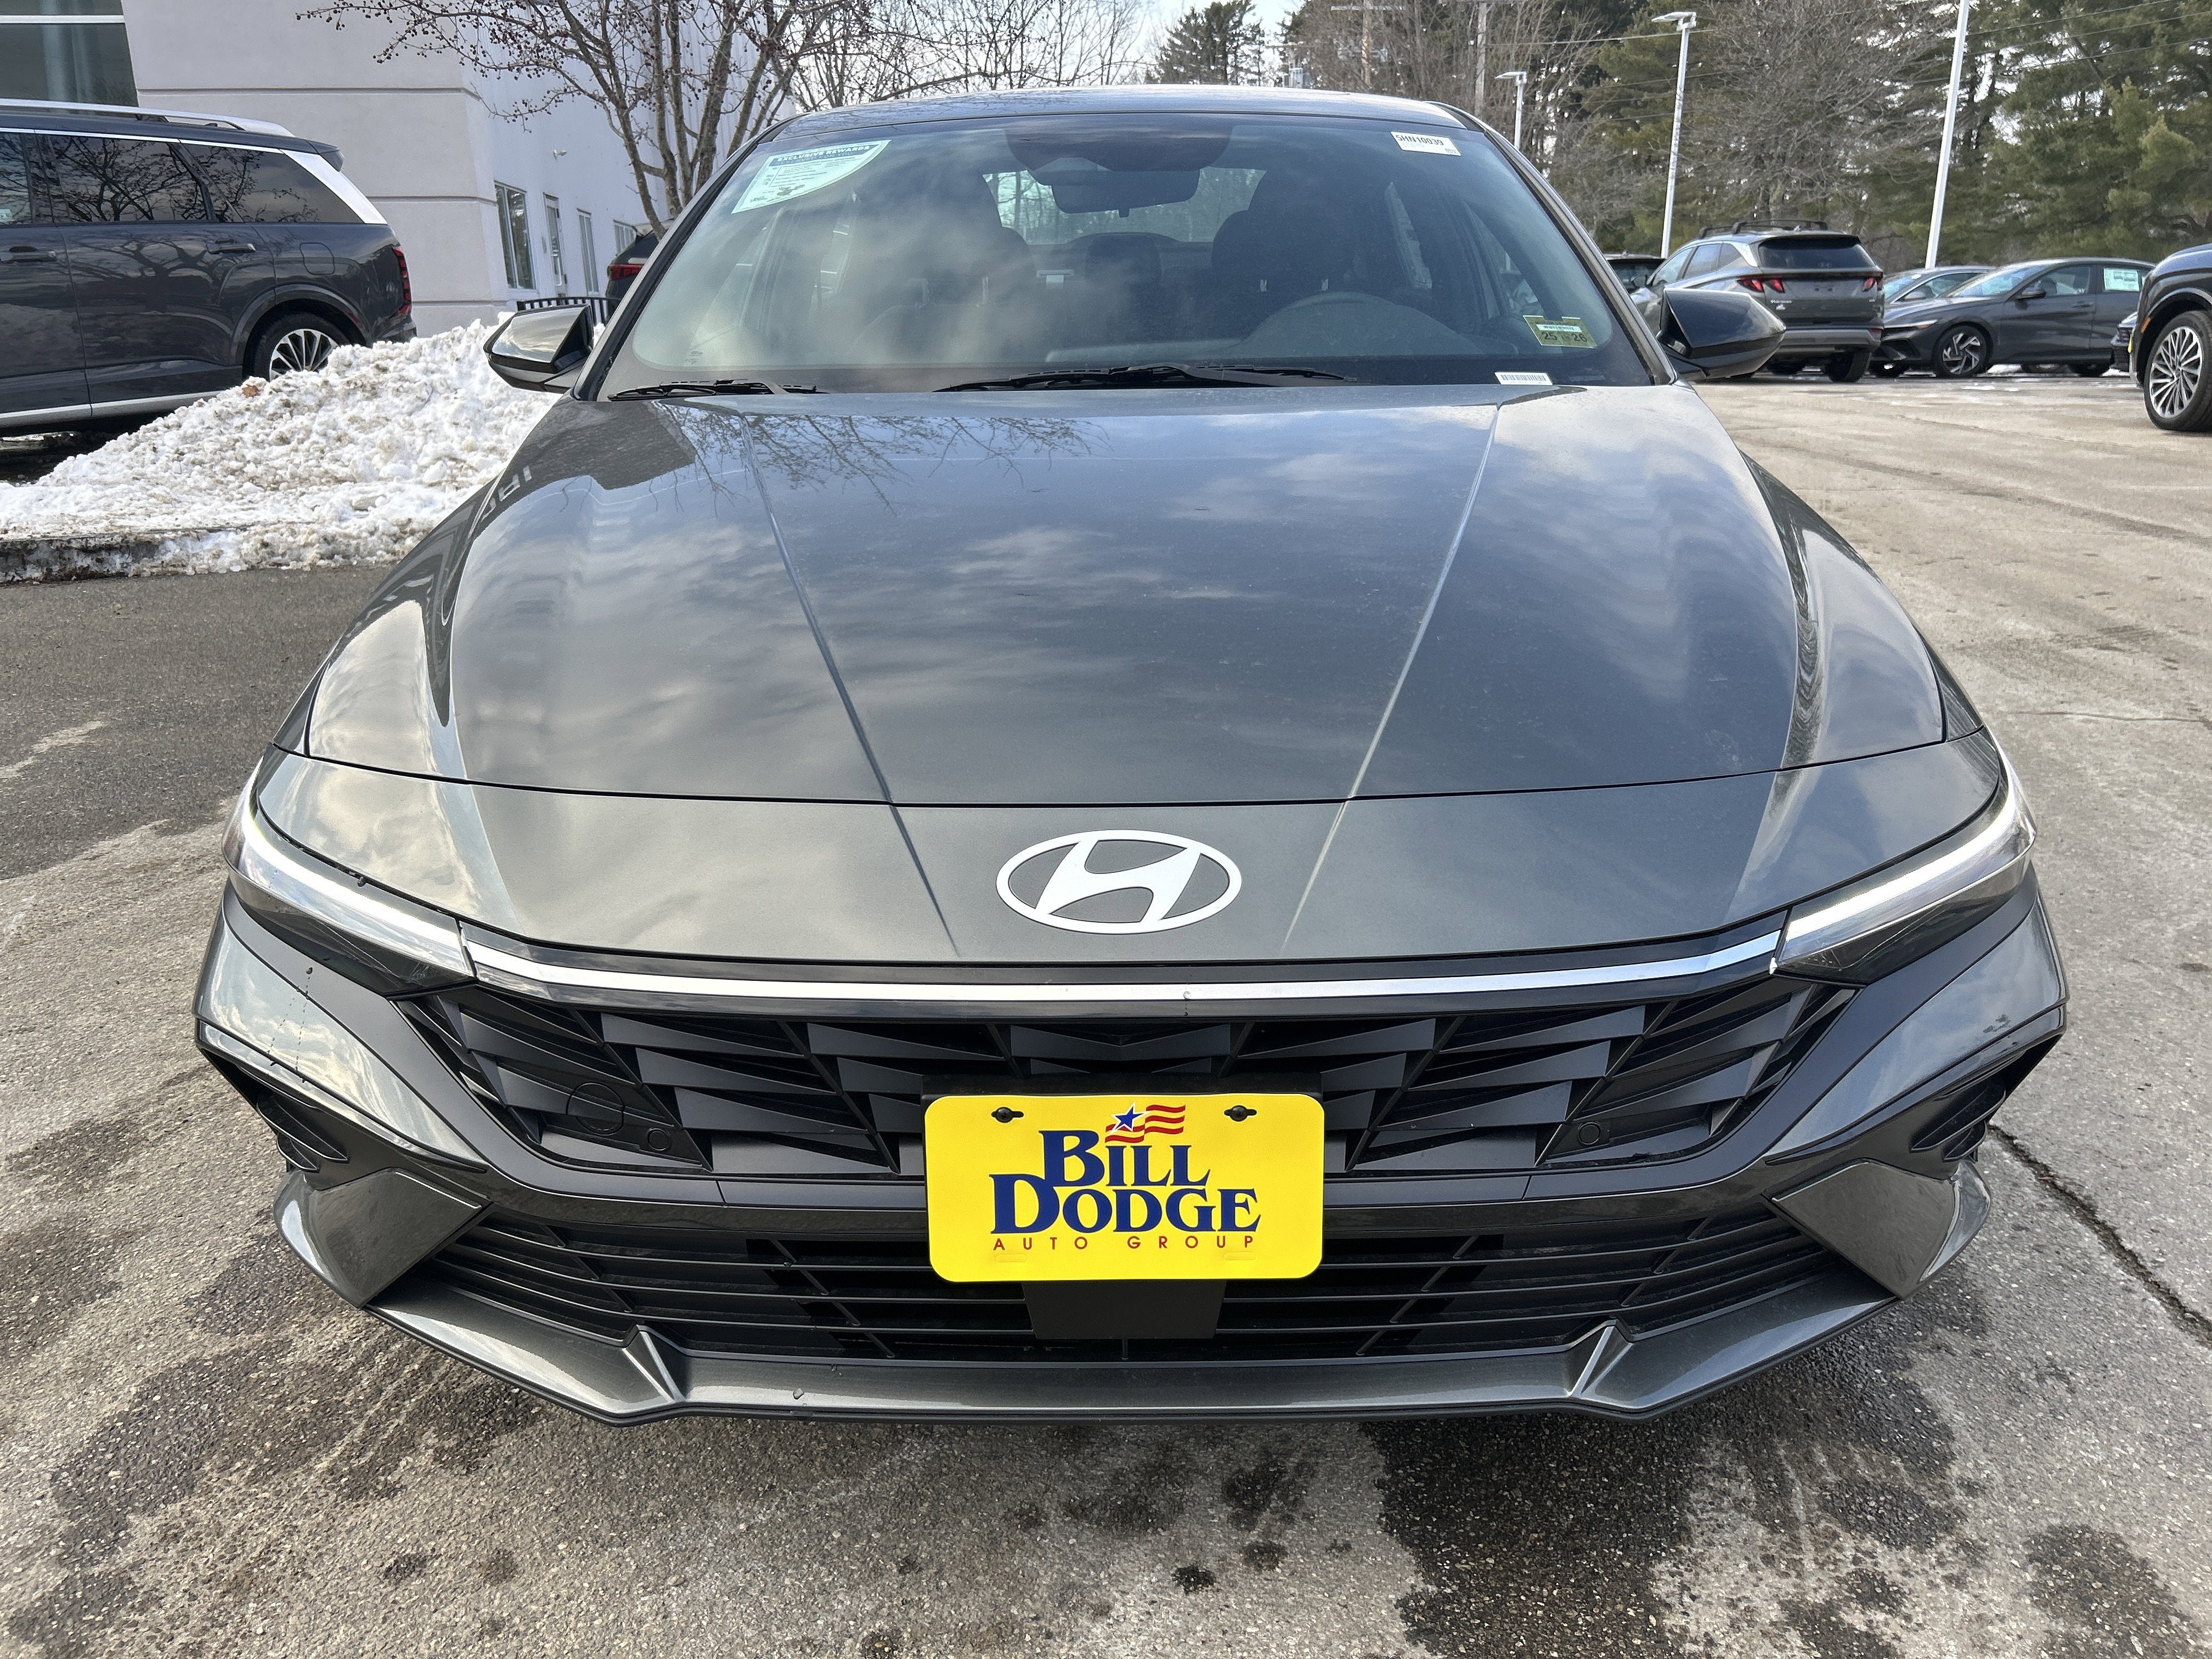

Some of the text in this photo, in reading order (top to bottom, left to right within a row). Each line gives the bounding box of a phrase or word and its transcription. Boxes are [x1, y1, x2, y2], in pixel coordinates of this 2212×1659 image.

[777, 145, 870, 162] EXCLUSIVE REWARDS
[1541, 332, 1558, 341] 25
[1039, 1130, 1211, 1187] BILL
[989, 1173, 1261, 1234] DODGE
[993, 1235, 1254, 1251] AUTO GROUP
